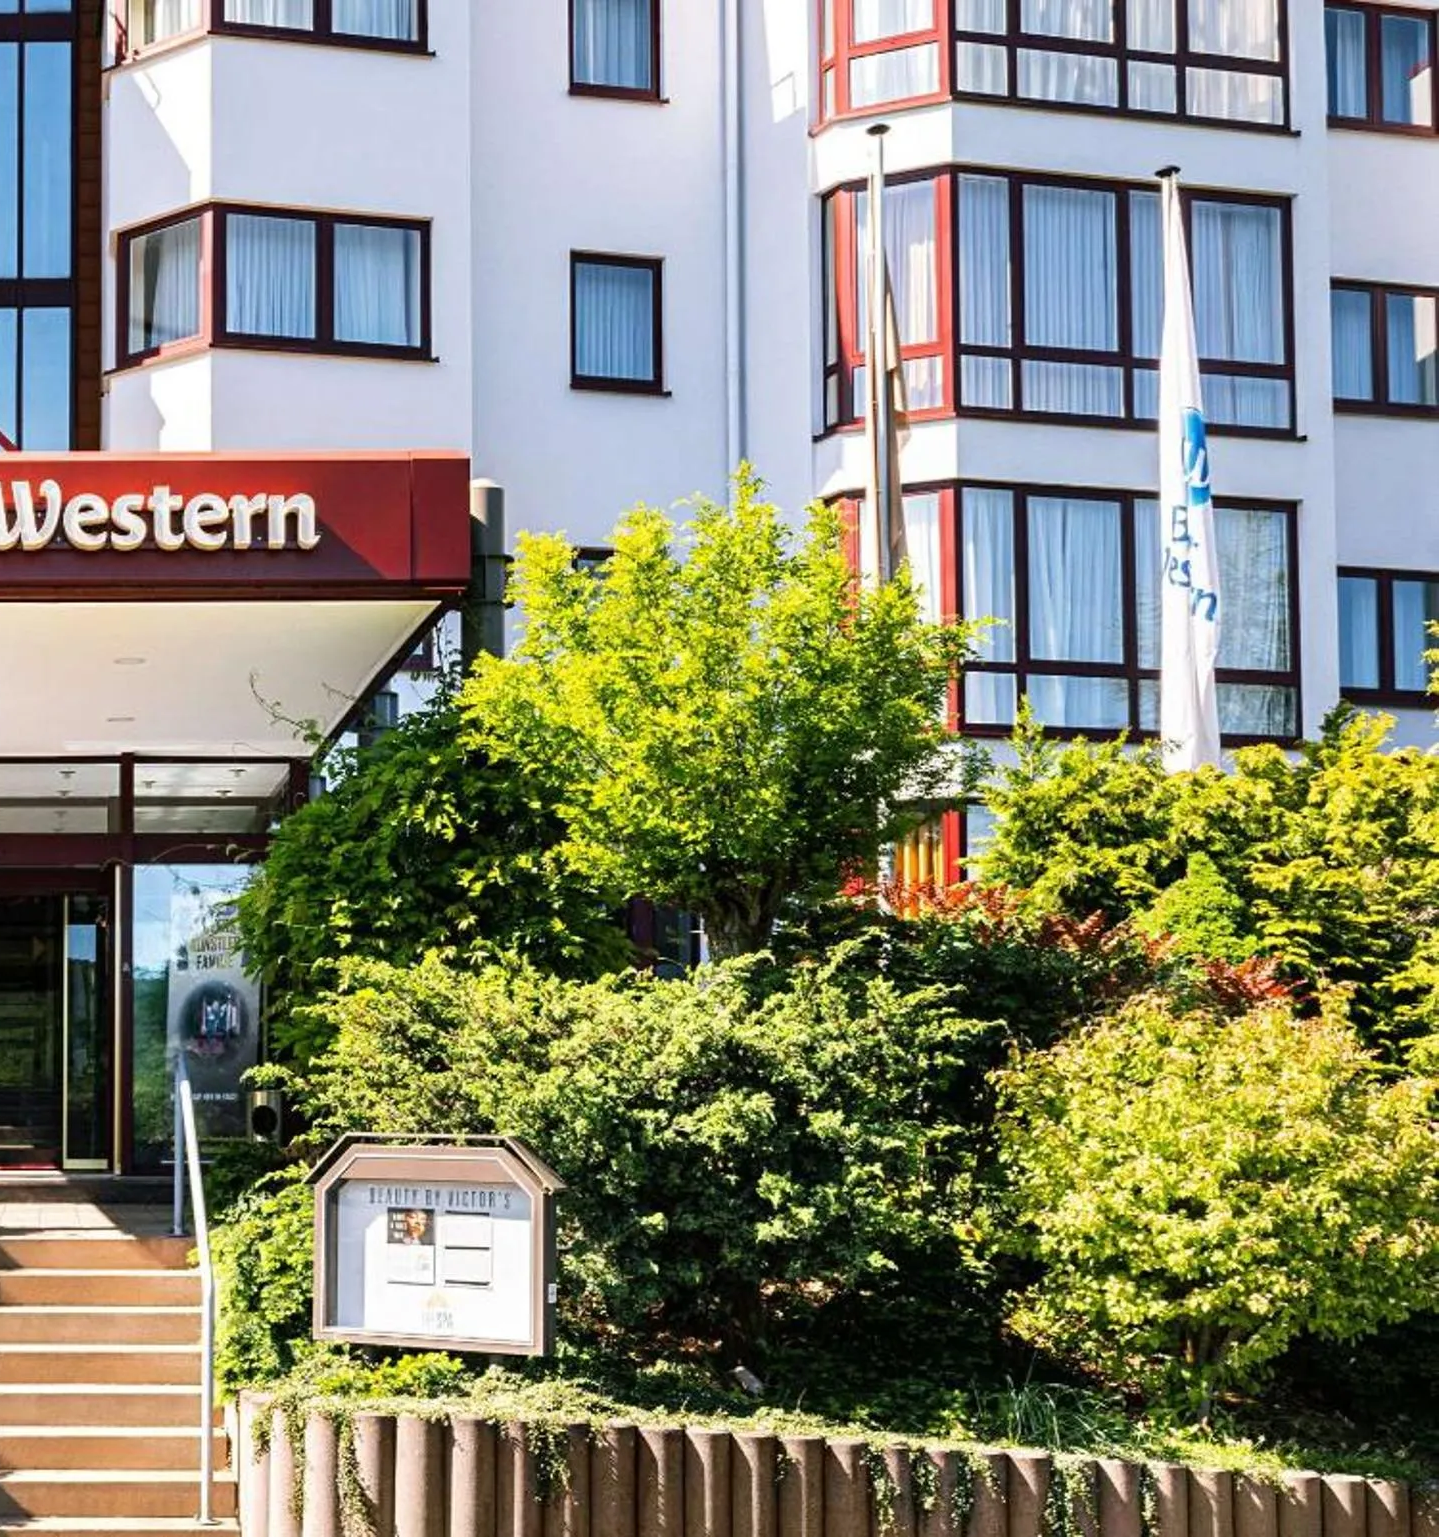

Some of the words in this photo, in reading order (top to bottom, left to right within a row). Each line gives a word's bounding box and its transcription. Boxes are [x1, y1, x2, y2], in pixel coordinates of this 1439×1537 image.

[370, 1187, 419, 1204] BEAUTY
[425, 1189, 441, 1206] BY
[448, 1190, 512, 1209] VICTOR'S
